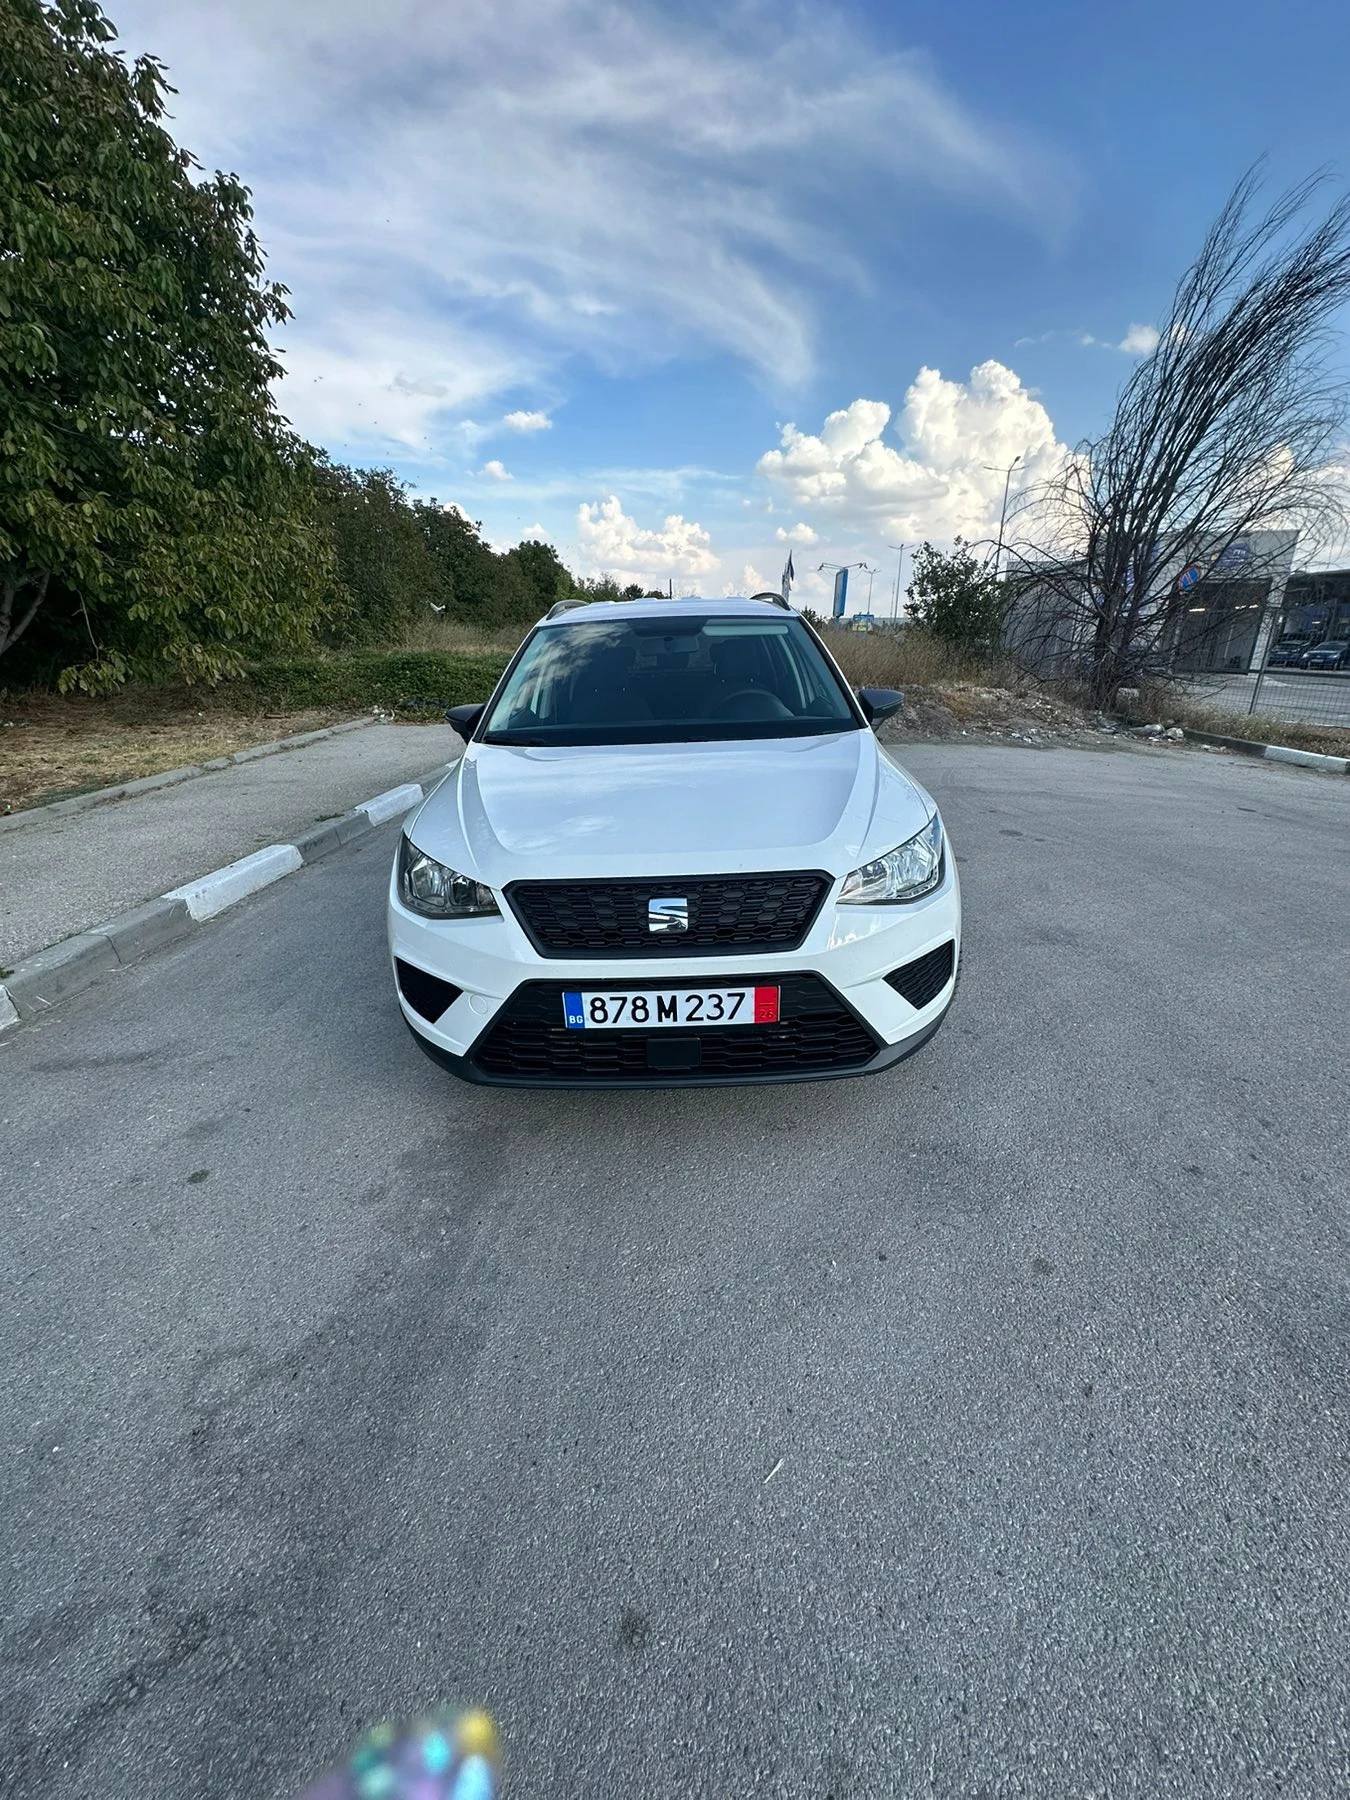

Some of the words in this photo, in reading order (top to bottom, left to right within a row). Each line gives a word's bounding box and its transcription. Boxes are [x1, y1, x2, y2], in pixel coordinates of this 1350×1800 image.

[589, 996, 650, 1024] 878
[656, 995, 678, 1022] M
[685, 992, 746, 1022] 237
[569, 1015, 584, 1024] BG
